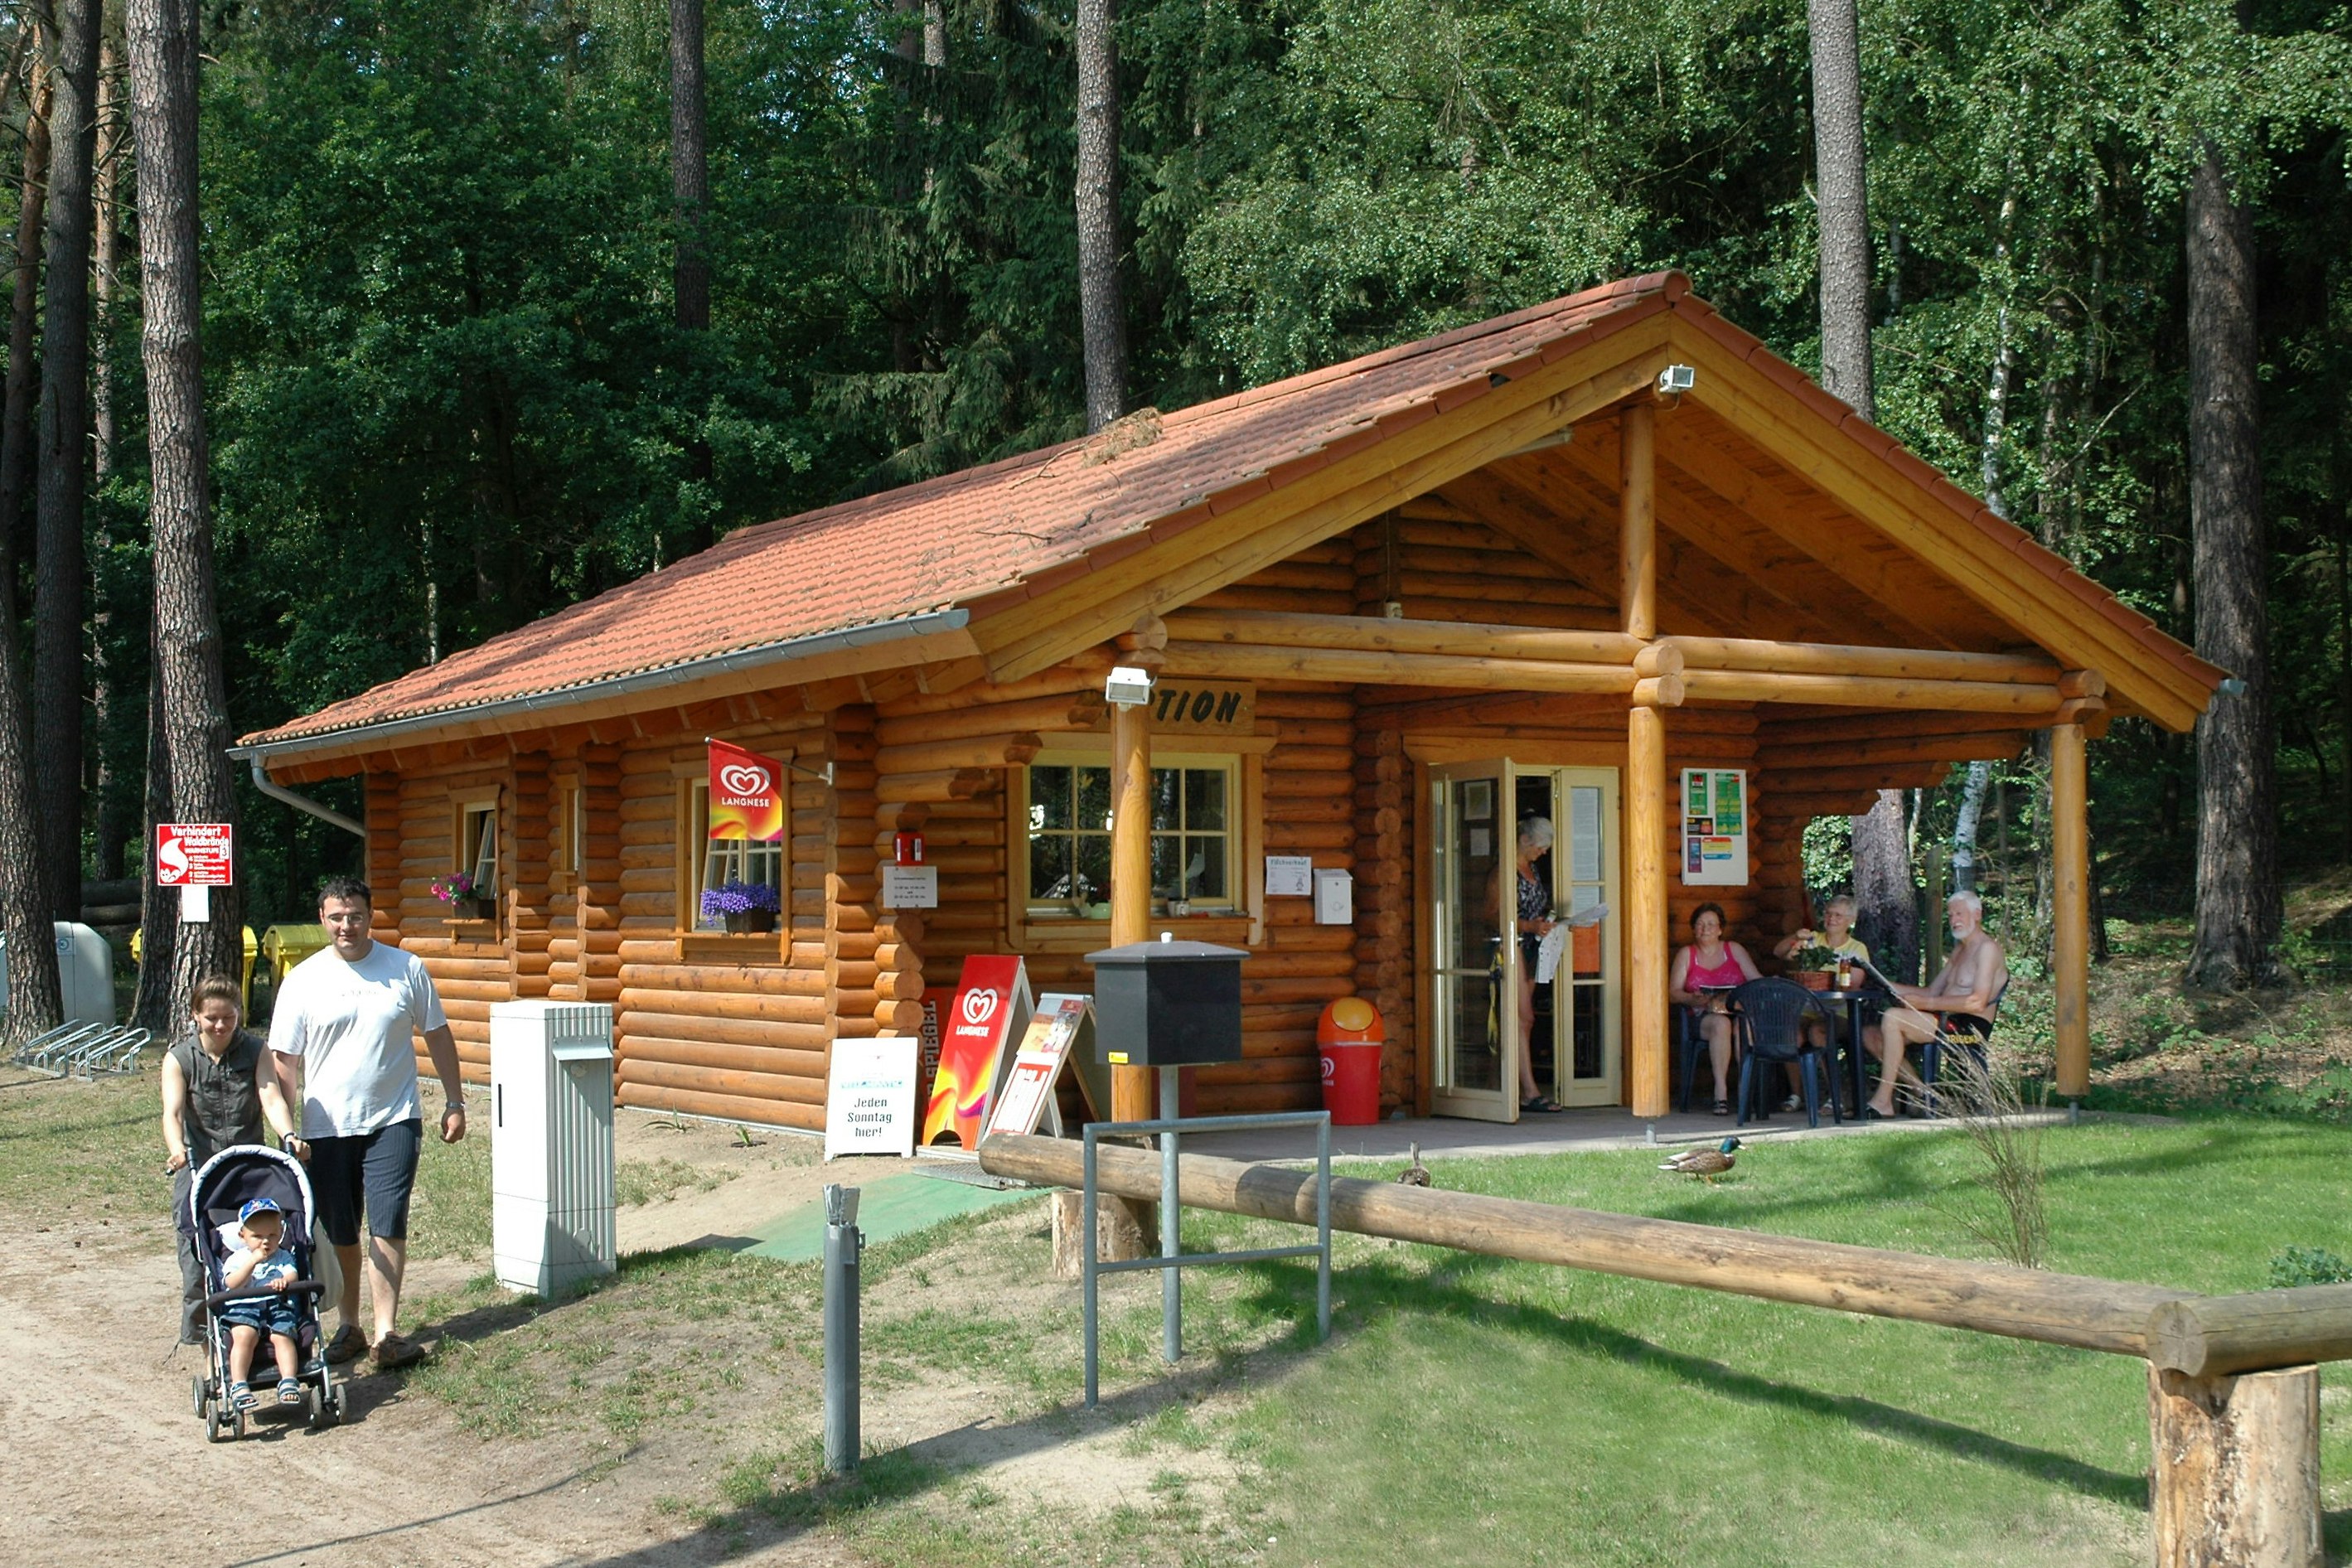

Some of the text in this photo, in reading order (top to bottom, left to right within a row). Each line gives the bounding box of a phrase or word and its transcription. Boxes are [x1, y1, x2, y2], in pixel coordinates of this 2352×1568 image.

[721, 796, 769, 807] LANGNESE
[171, 825, 221, 836] Verhindert
[956, 1025, 990, 1038] LANGNESE
[923, 999, 940, 1078] SPIEGEL
[854, 1097, 888, 1108] Jeden
[847, 1112, 893, 1124] Sonntag
[855, 1126, 883, 1138] hier!
